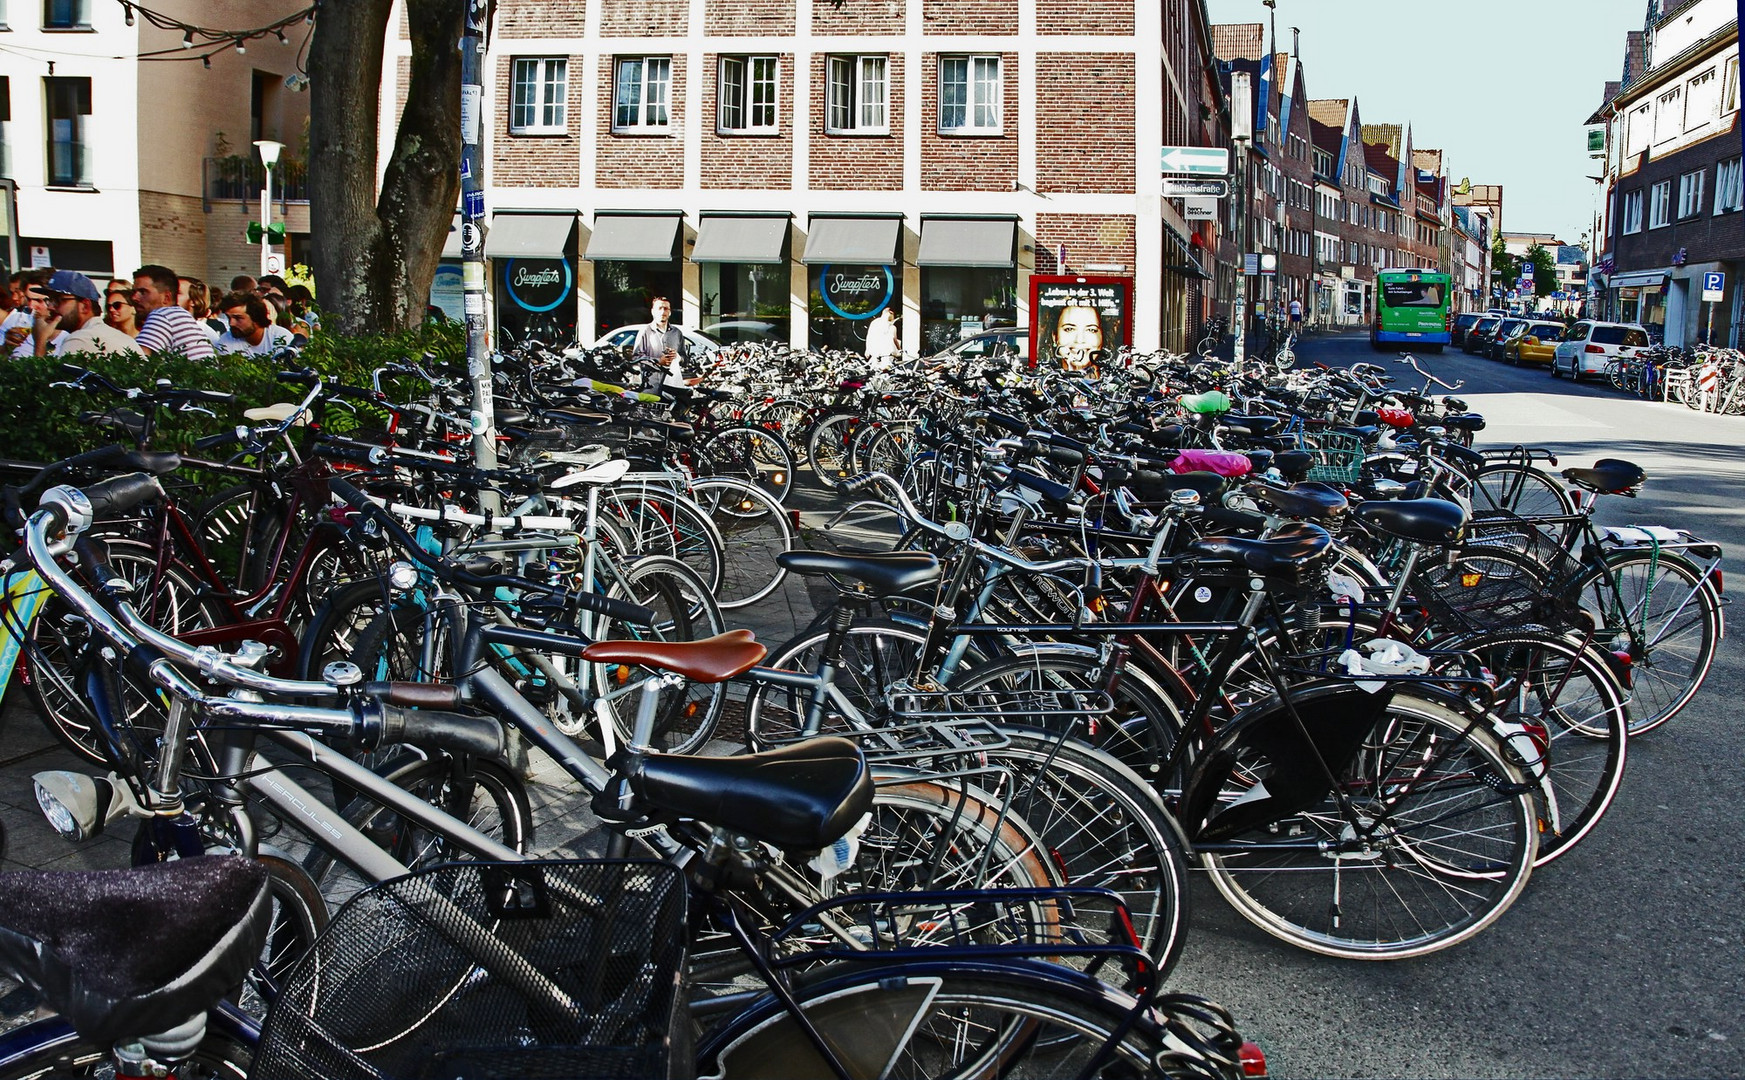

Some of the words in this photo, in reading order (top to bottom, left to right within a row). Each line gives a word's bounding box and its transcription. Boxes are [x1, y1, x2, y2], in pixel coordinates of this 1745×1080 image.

[514, 267, 560, 288] Swapfiets
[830, 273, 881, 294] Swapfiets
[1708, 275, 1720, 289] P
[1090, 288, 1097, 297] 3.
[1098, 288, 1115, 297] Welt
[262, 773, 343, 840] HERCULES
